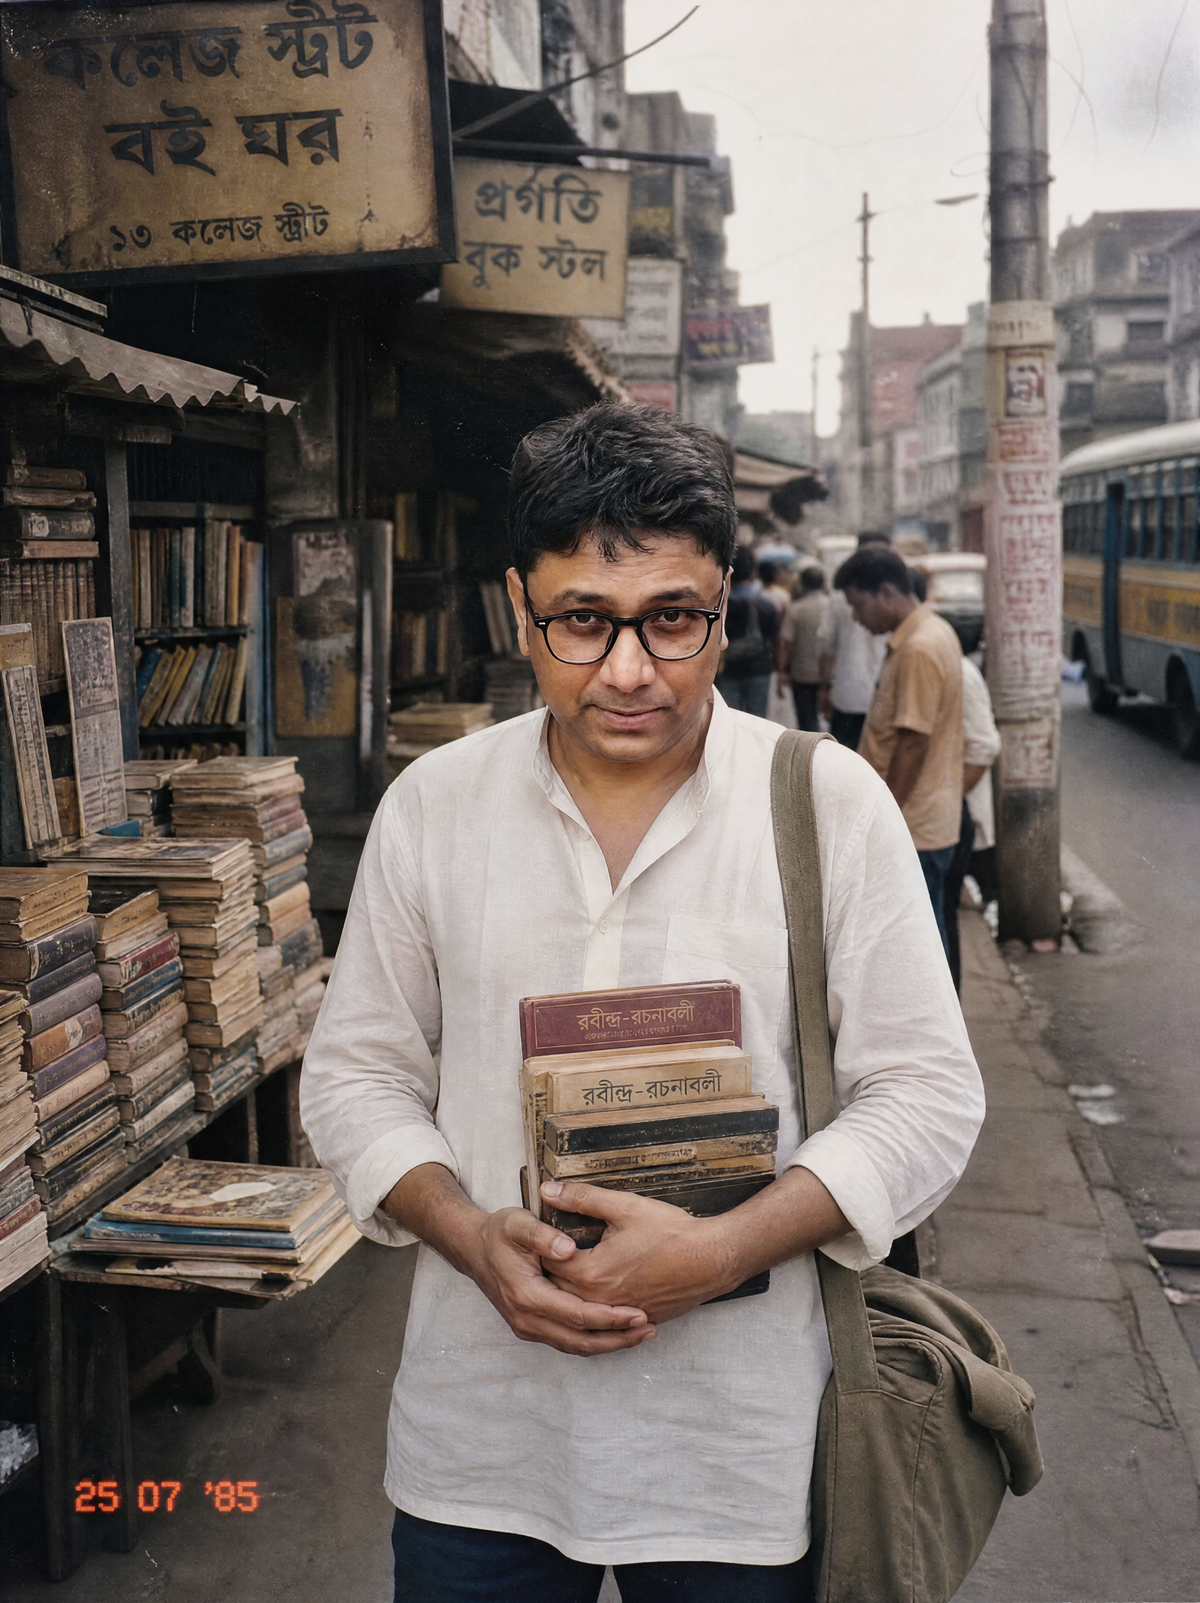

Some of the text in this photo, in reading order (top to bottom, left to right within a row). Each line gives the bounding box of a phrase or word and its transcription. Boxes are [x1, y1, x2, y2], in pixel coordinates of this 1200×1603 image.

[38, 26, 242, 91] কলেজ
[102, 99, 344, 177] বই ঘর
[110, 201, 330, 252] ১৩ কলেজ স্ট্রীট
[475, 172, 602, 225] প্রগতি
[463, 233, 608, 290] বুক স্টল
